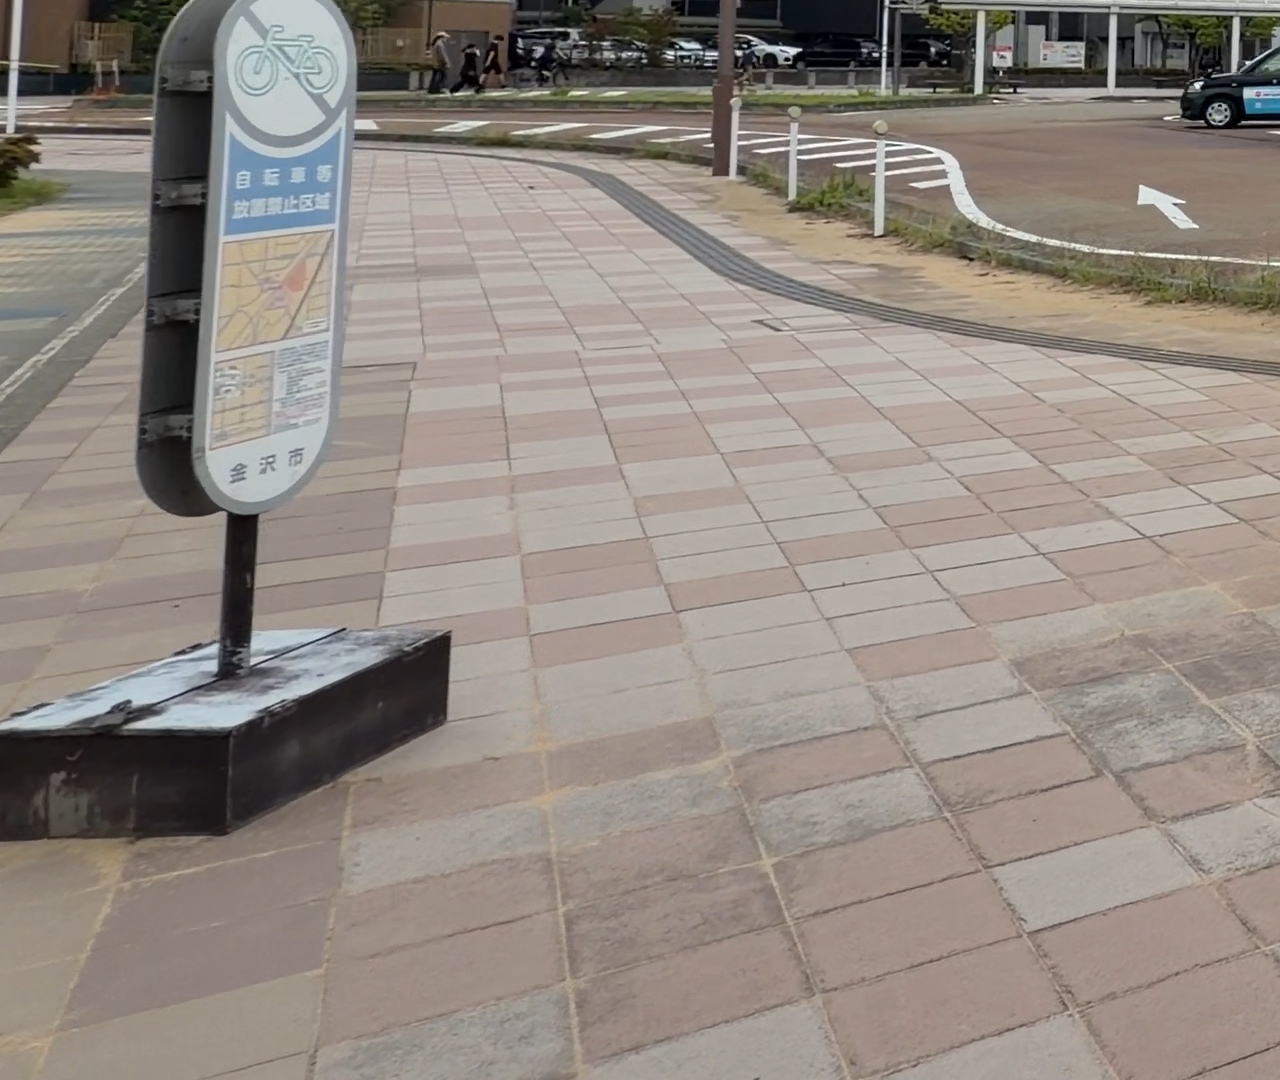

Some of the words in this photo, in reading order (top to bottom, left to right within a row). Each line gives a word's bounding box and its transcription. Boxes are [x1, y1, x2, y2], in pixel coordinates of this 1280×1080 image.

[236, 164, 333, 189] 自転車等
[229, 447, 305, 484] 金沢市
